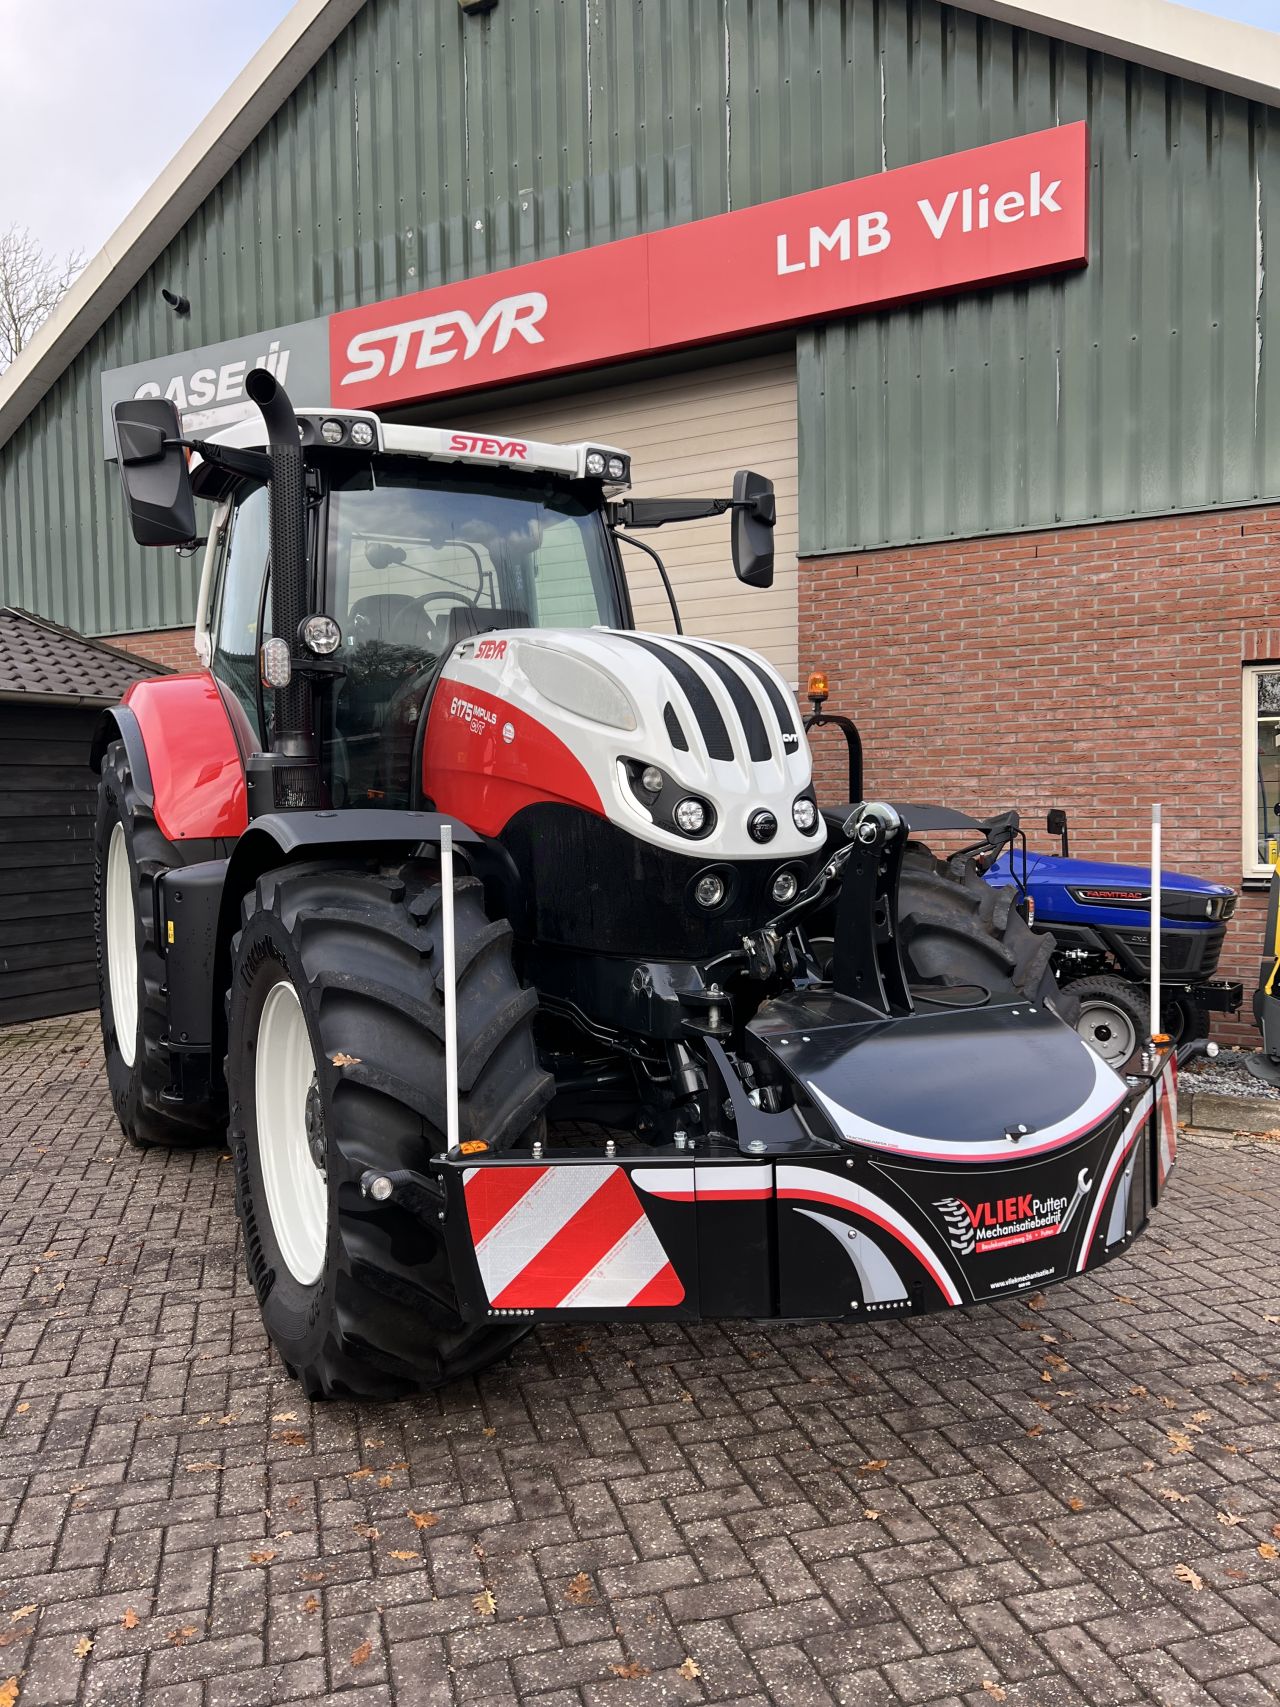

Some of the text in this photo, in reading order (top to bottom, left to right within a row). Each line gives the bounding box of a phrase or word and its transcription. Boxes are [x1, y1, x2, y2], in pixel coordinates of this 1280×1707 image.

[776, 171, 1063, 276] LMB Vliek
[340, 291, 549, 386] STEYR
[448, 434, 528, 460] STEYR
[473, 639, 508, 660] STEYR
[450, 696, 498, 725] 6175 IMPULS
[782, 733, 799, 743] CVT
[1086, 890, 1143, 899] FARMTRAC
[956, 1194, 1068, 1228] VLIEK Putten
[976, 1209, 1062, 1241] Mechanisatiebedrijf
